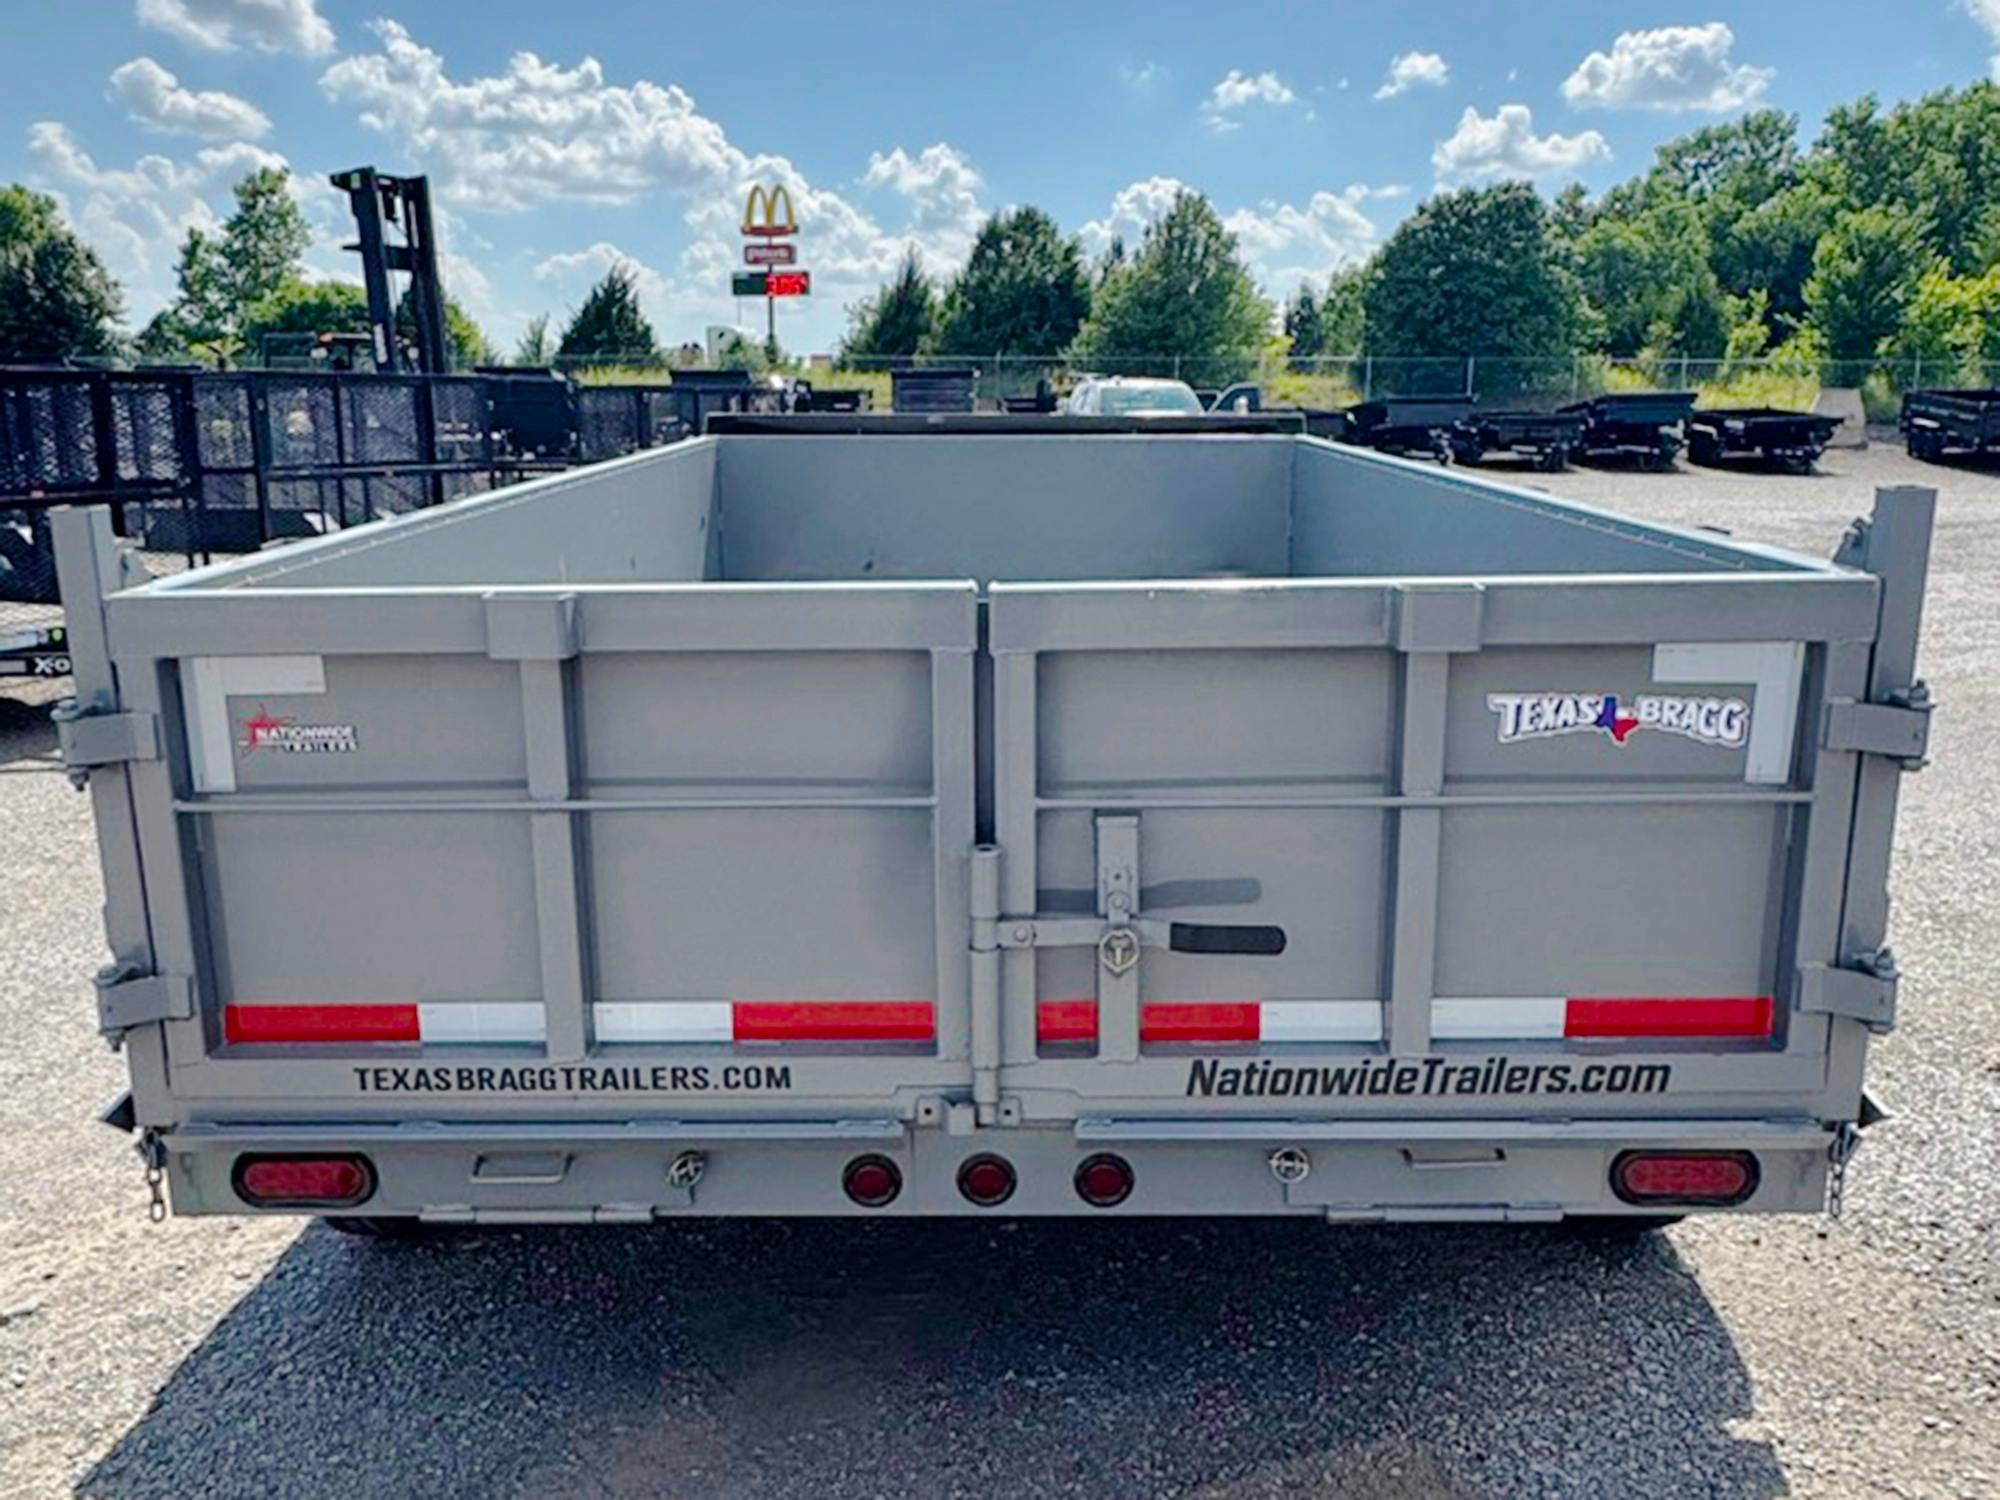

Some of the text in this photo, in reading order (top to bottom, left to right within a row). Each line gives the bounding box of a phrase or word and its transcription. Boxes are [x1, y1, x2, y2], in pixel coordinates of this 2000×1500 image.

[1488, 693, 1747, 743] TEXAS BRAGG
[254, 726, 354, 740] NATIONWIDE
[282, 741, 357, 752] TRAILERS
[1186, 1057, 1672, 1097] NationwideTrailers.com
